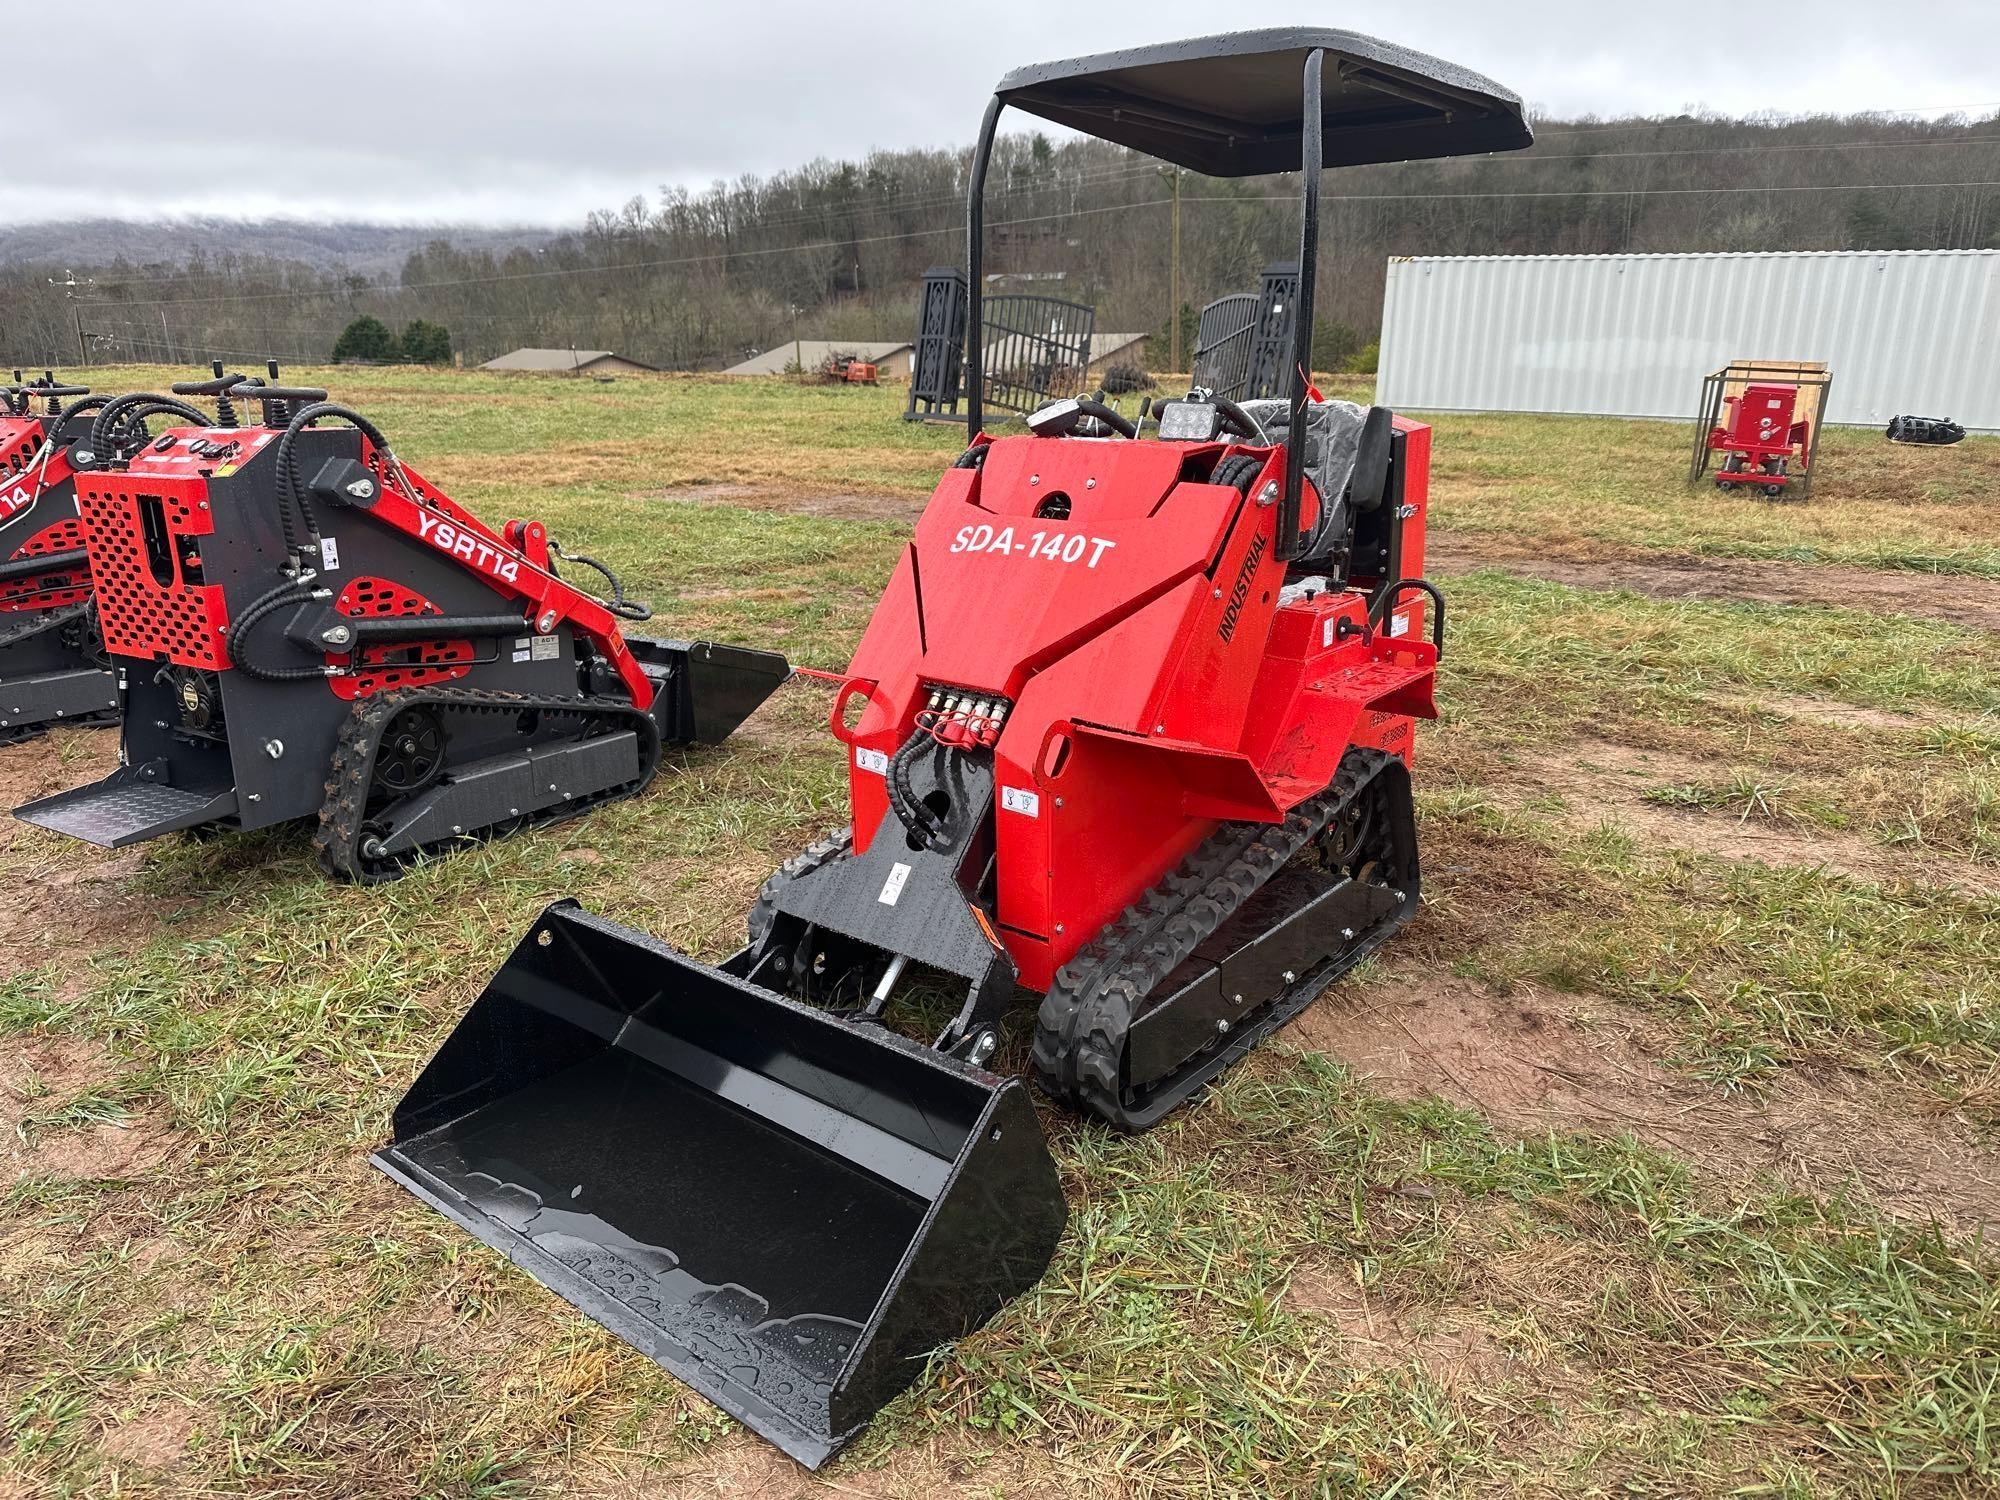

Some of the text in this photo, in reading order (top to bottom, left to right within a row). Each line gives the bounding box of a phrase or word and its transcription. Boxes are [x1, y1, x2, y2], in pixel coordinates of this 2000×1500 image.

[0, 487, 31, 519] 14
[419, 510, 519, 583] YSRT14
[950, 524, 1117, 568] SDA-140T
[1219, 533, 1267, 643] INDUSTRIAL
